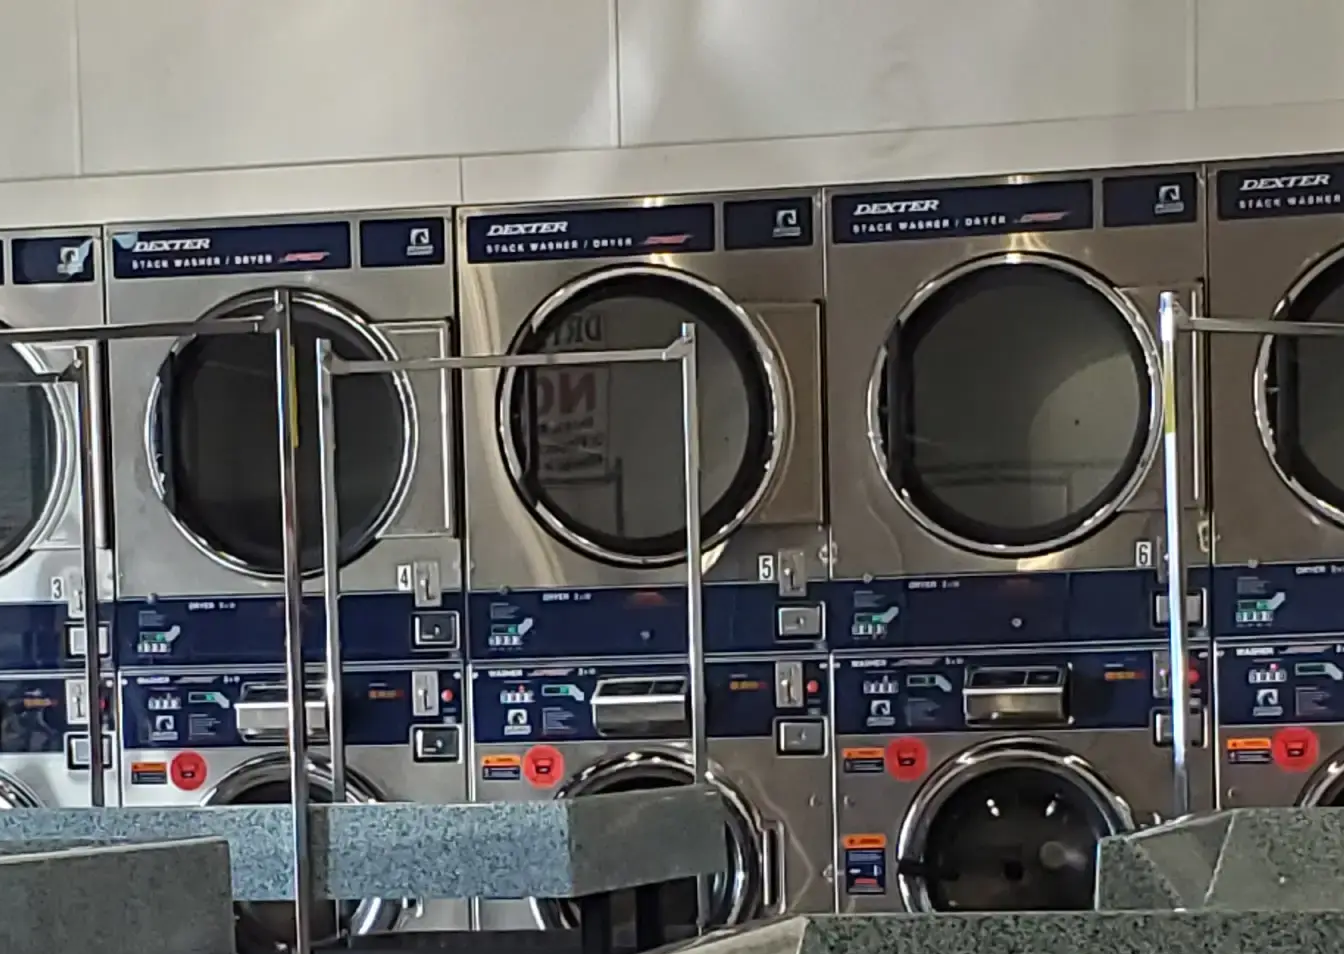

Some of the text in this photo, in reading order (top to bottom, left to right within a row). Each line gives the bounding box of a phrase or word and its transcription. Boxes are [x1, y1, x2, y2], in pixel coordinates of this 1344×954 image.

[1239, 173, 1331, 191] DEXTER
[853, 199, 940, 216] DEXTER
[1239, 196, 1282, 210] STACK
[1287, 192, 1341, 206] WASHER
[486, 221, 568, 237] DEXTER
[852, 222, 893, 234] STACK
[898, 217, 950, 231] WASHER
[965, 214, 1006, 227] DRYER
[132, 237, 211, 253] DEXTER
[486, 241, 525, 254] STACK
[529, 238, 578, 252] WASHER
[592, 237, 633, 248] DRYER
[132, 257, 169, 270] STACK
[174, 255, 221, 268] WASHER
[234, 253, 273, 265] DRYER
[1139, 544, 1149, 565] 6
[762, 557, 772, 579] 5
[399, 567, 409, 588] 4
[53, 578, 63, 600] 3
